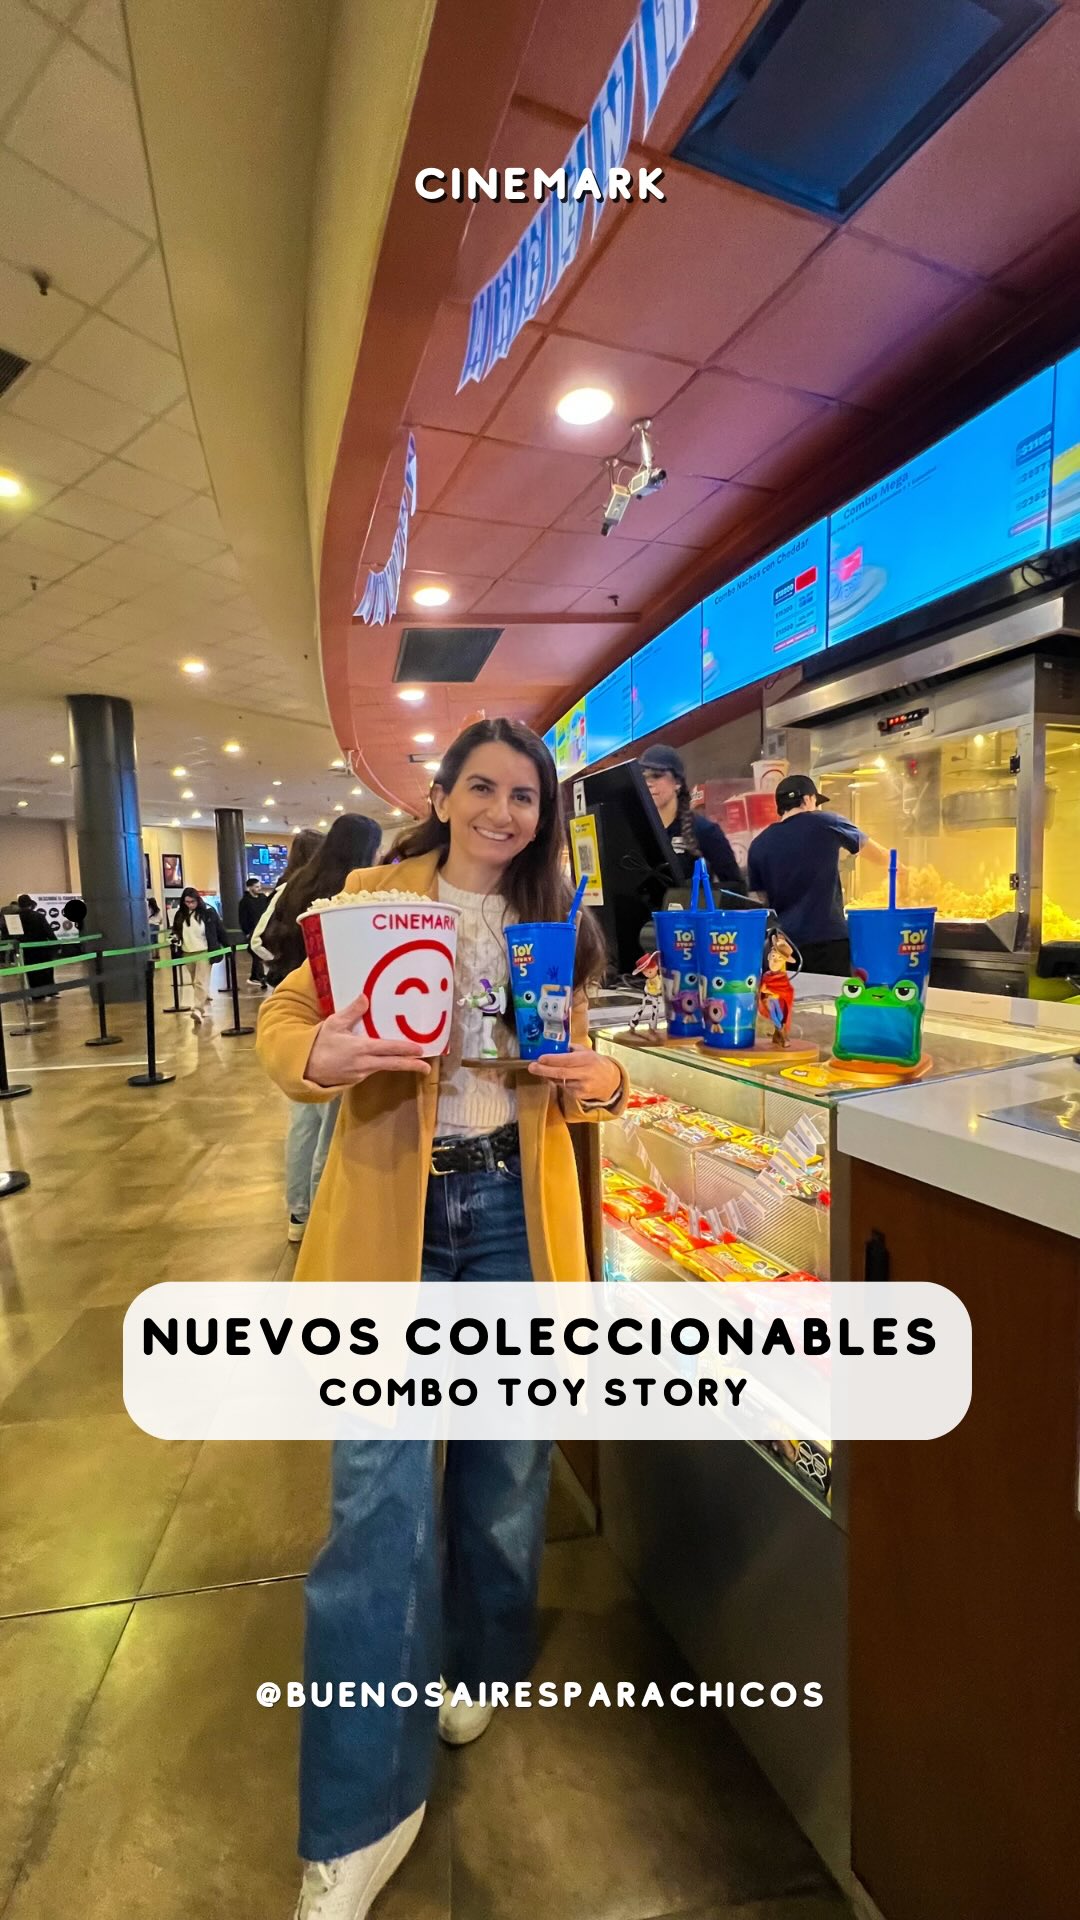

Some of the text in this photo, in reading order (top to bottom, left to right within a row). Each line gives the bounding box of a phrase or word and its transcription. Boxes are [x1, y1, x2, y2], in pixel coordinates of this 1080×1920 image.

[843, 494, 878, 520] Combo
[879, 472, 908, 497] Mega
[714, 538, 809, 605] Combo Nachos con Cheddar
[576, 794, 582, 811] 7
[372, 913, 456, 930] CINEMARK
[709, 931, 738, 945] TOY
[899, 928, 928, 944] TOY
[511, 943, 534, 957] TOY
[683, 948, 692, 960] 5
[719, 952, 729, 966] 5
[908, 952, 919, 968] 5
[519, 963, 528, 977] 5
